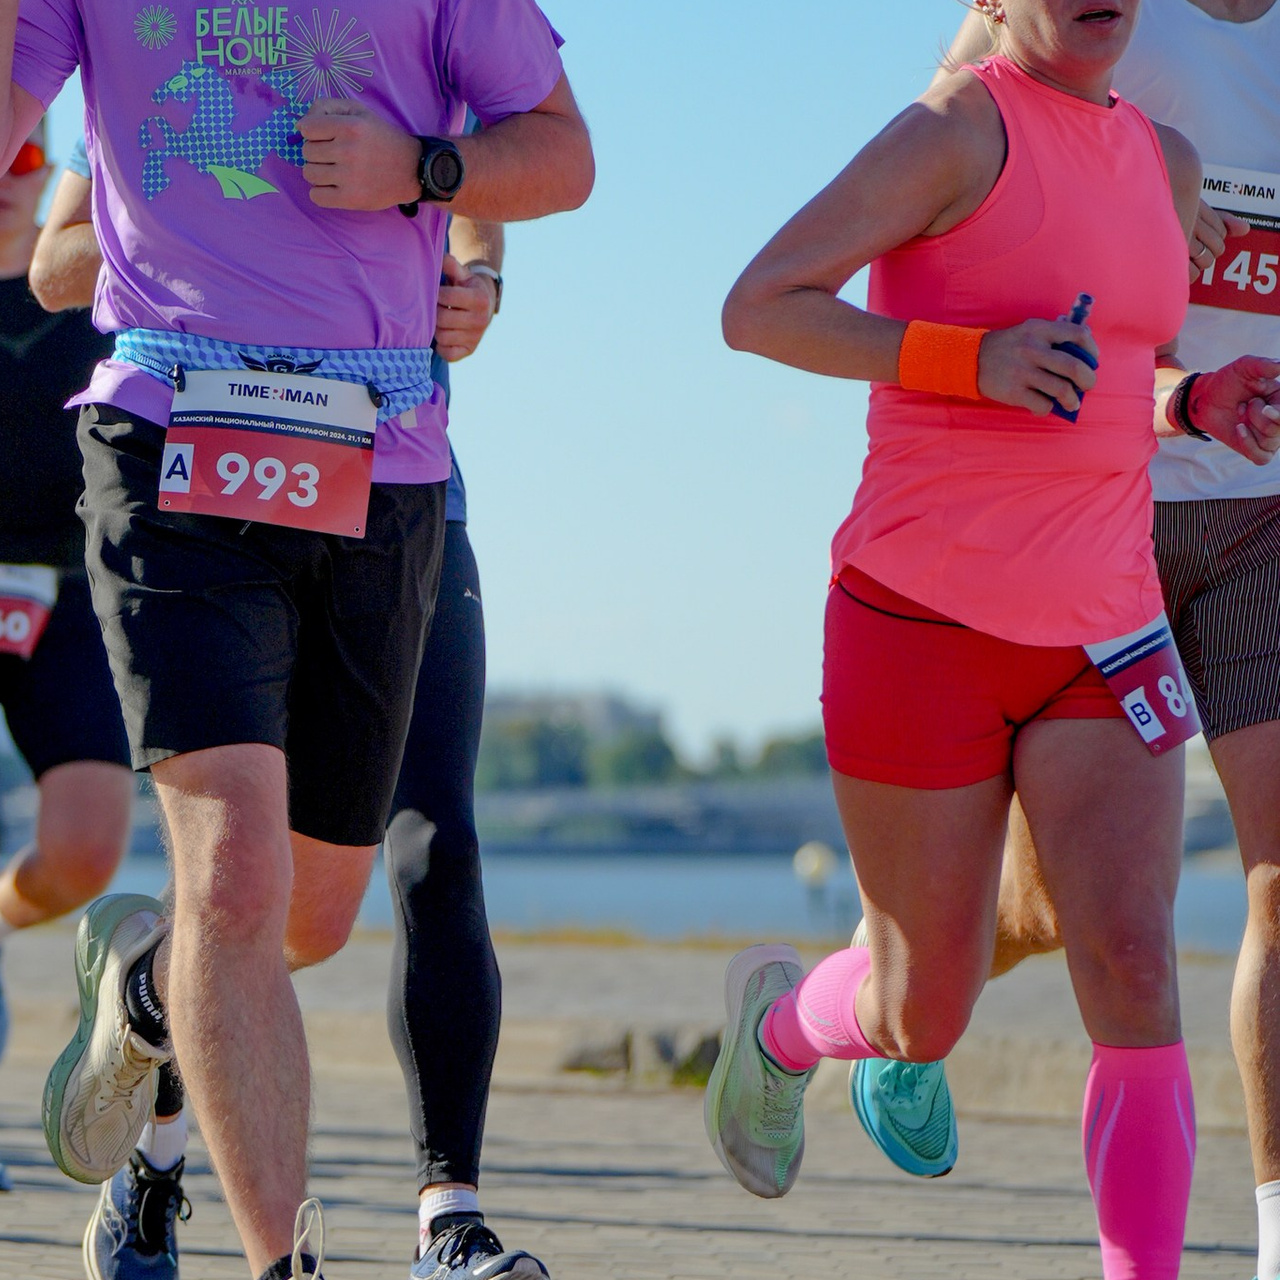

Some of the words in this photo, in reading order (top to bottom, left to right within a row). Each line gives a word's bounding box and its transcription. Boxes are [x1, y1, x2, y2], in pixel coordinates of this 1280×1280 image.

[196, 7, 289, 37] БЕЛЫЕ
[196, 38, 288, 67] НОЧИ
[225, 67, 263, 76] МАРАФОН
[173, 415, 214, 423] КАЗАНСКИЙ
[214, 417, 275, 429] НАЦИОНАЛЬНЫЙ
[275, 423, 329, 437] ПОЛУМАРАФОН
[361, 436, 372, 445] КМ
[165, 453, 189, 481] A
[216, 452, 320, 508] 993
